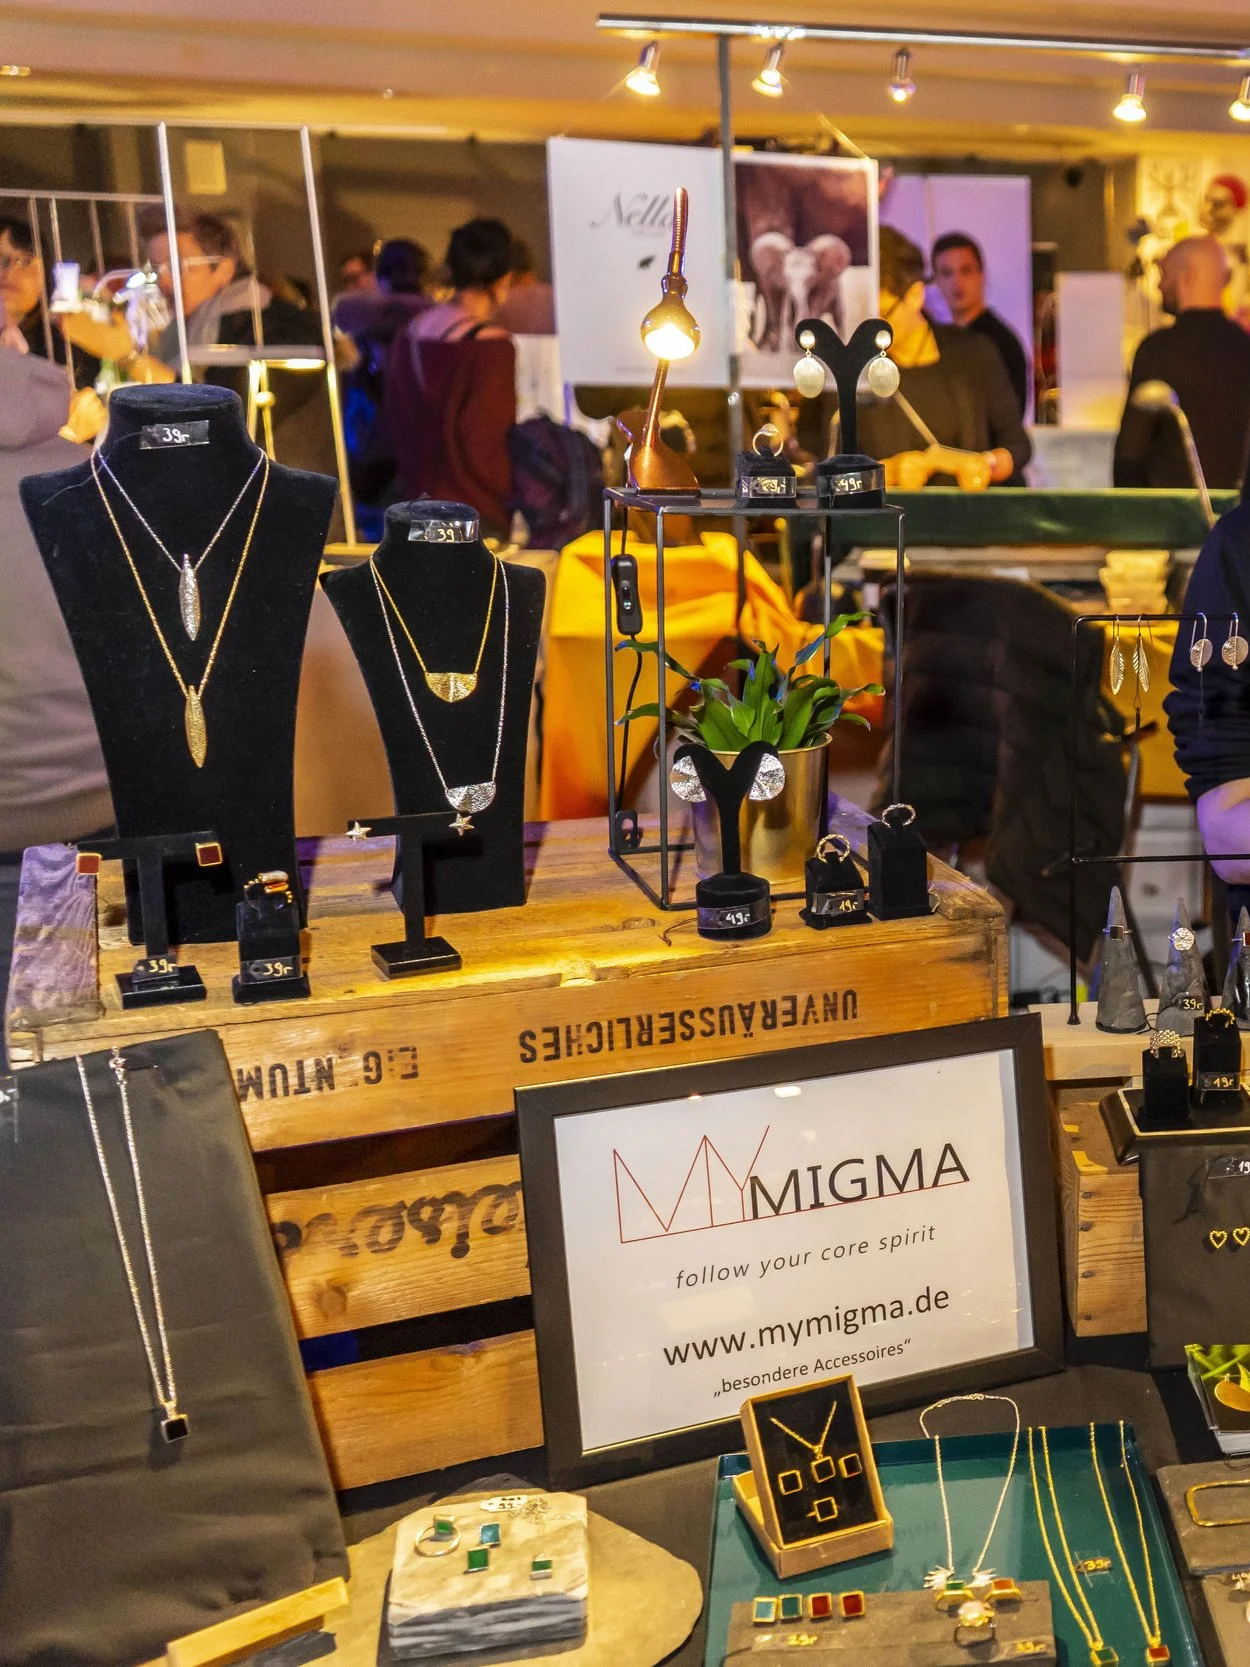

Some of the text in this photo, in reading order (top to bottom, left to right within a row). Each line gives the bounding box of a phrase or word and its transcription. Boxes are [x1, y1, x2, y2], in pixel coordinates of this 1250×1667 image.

[518, 988, 859, 1065] UNVERÄUSSERLICHES
[676, 1225, 936, 1289] follow your core spirit
[663, 1285, 950, 1366] www.mymigma.de
